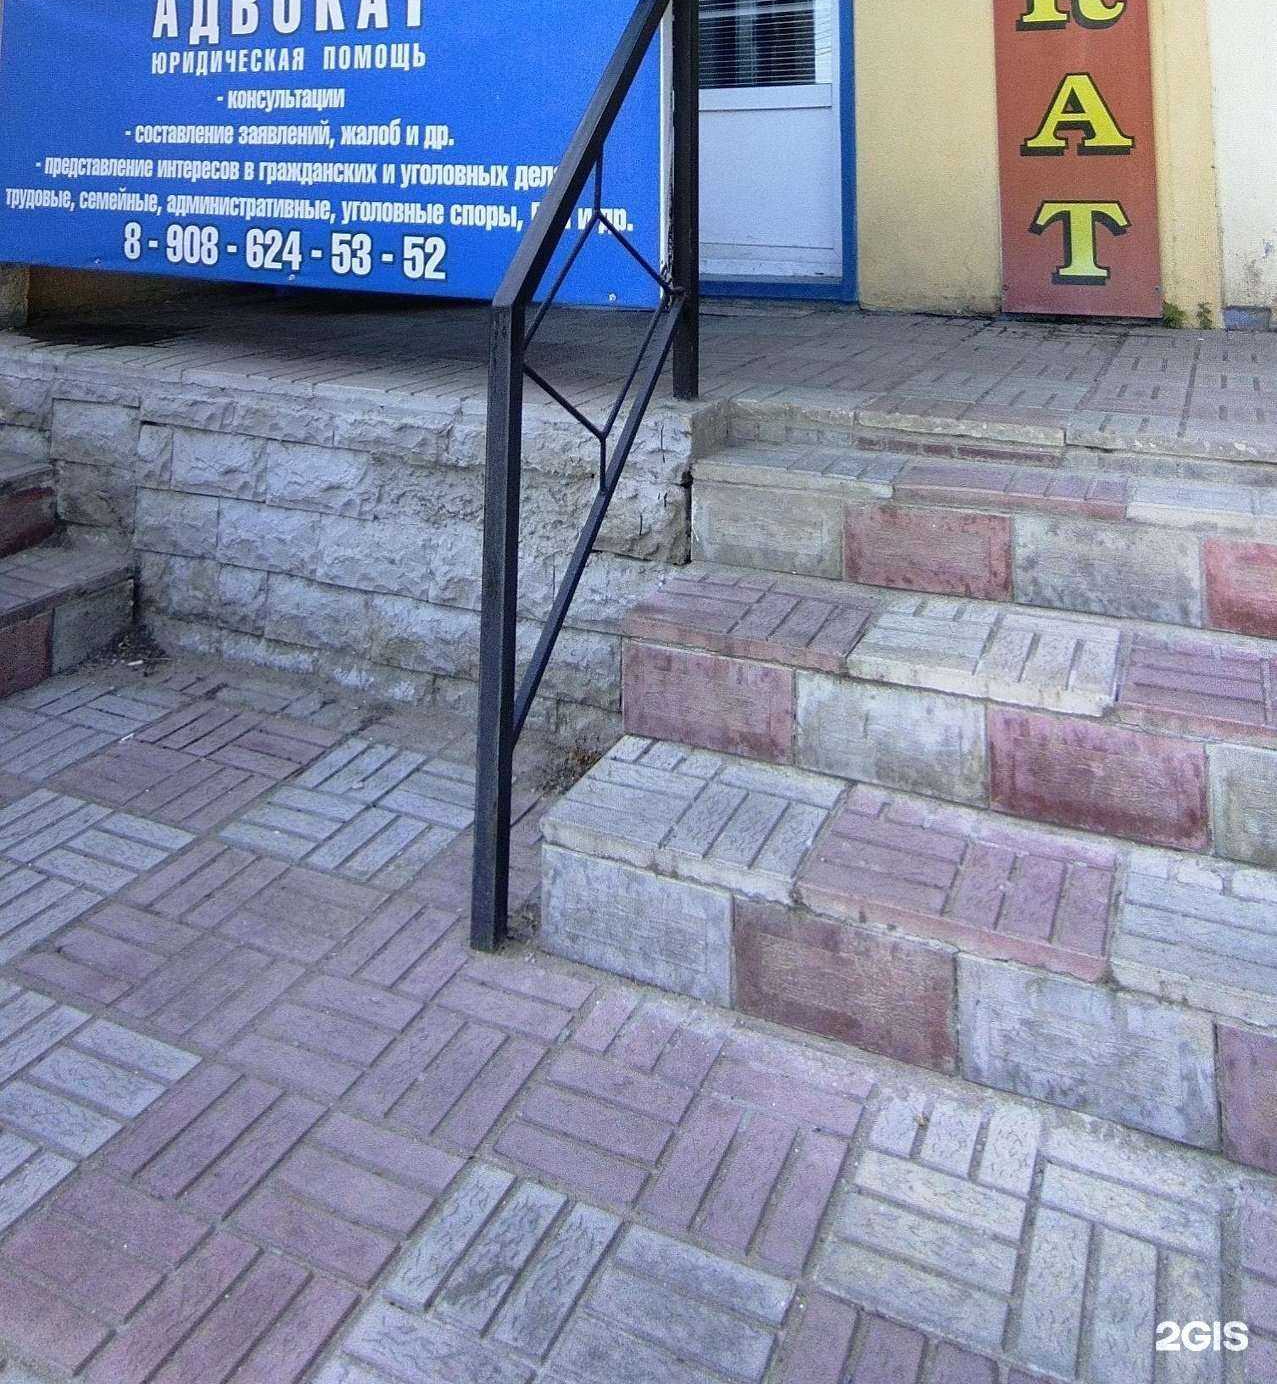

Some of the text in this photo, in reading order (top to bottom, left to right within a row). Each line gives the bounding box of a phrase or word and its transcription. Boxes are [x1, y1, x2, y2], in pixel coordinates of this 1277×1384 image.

[151, 43, 427, 75] ЮРИДИЧЕСКАЯ ПОМОЩЬ
[227, 88, 345, 111] консультации
[135, 125, 233, 144] составление
[238, 120, 335, 149] заявлений,
[340, 119, 401, 146] жалоб
[406, 126, 418, 145] и
[423, 125, 455, 149] др.
[44, 157, 153, 177] представление
[157, 160, 239, 182] интересов
[244, 163, 254, 180] в
[259, 162, 377, 185] гражданских
[383, 165, 395, 184] и
[400, 165, 508, 188] уголовных
[5, 187, 75, 212] трудовые,
[79, 187, 162, 215] семейные,
[166, 194, 335, 224] административные,
[341, 200, 444, 224] уголовные
[450, 204, 524, 231] споры,
[124, 222, 141, 260] 8
[167, 224, 218, 265] 908
[246, 229, 301, 271] 624
[331, 232, 372, 275] 53
[403, 236, 446, 280] 52
